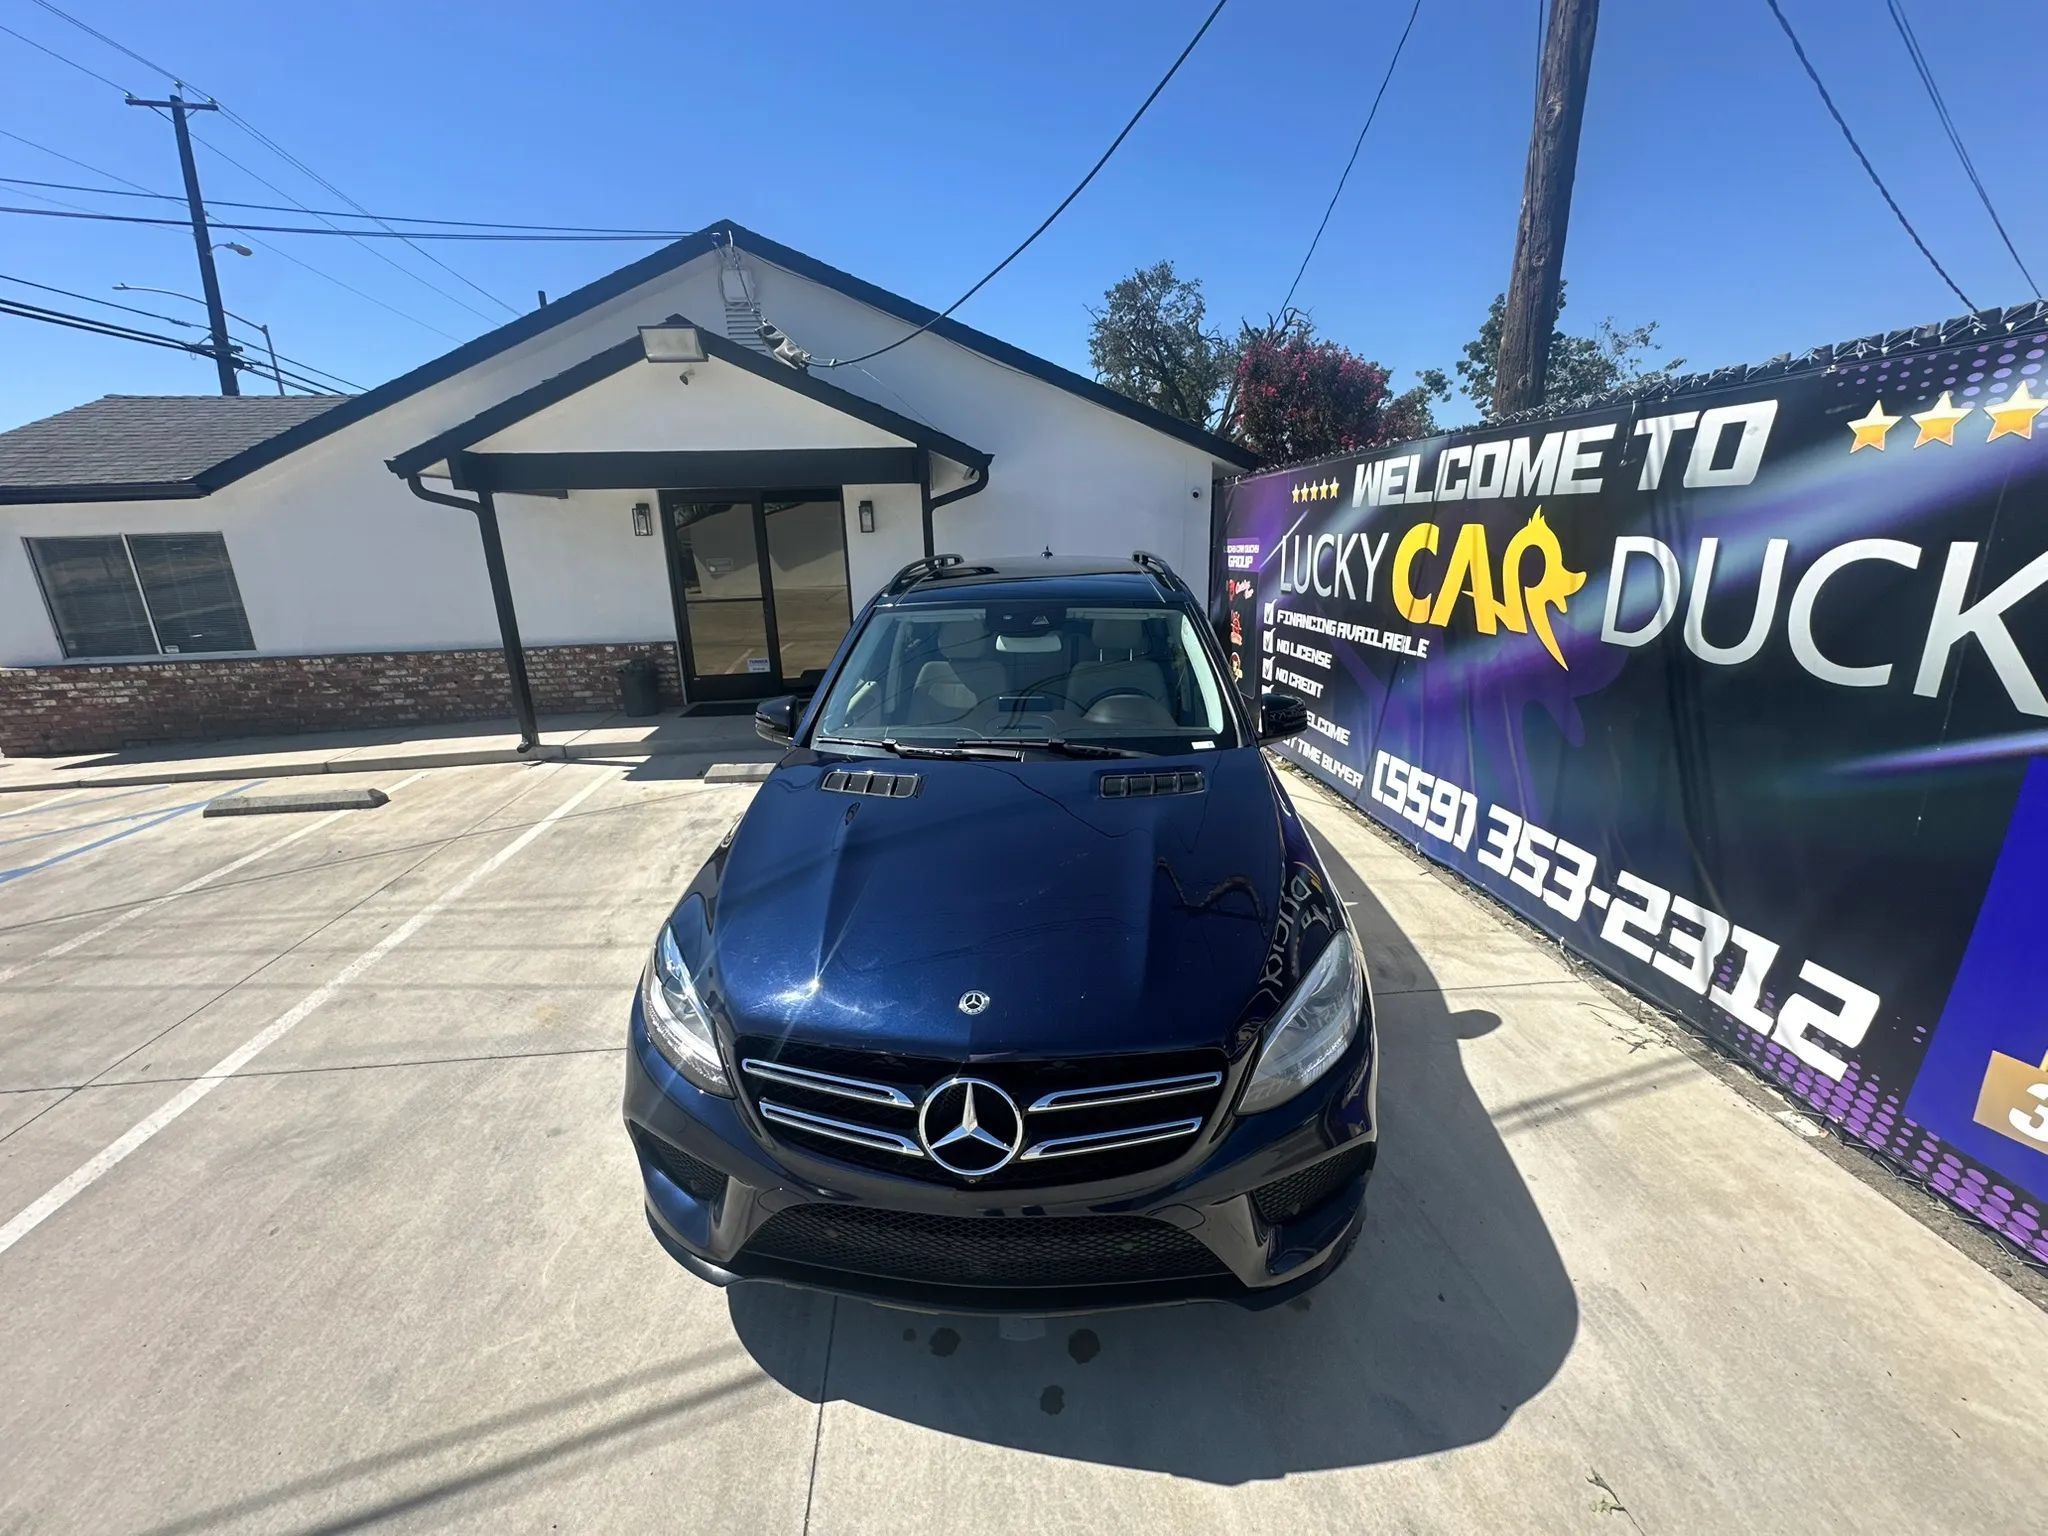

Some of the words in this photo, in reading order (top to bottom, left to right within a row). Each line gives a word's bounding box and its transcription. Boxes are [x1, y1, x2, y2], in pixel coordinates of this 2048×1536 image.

[1352, 423, 1617, 507] WELCOME
[1633, 399, 1778, 491] TO
[1228, 555, 1254, 569] GROUP
[1280, 532, 1389, 603] LUCKY
[1392, 504, 1587, 671] CAR
[1276, 638, 1290, 653] NO
[1290, 642, 1333, 669] LICENSE
[1277, 609, 1337, 637] FINANCING
[1337, 621, 1431, 659] AVAILABLE
[1275, 666, 1288, 684] NO
[1288, 670, 1324, 699] CREDIT
[1306, 710, 1351, 746] ELCOME
[1298, 738, 1322, 764] TIME
[1321, 752, 1364, 789] BUYER
[1371, 749, 1478, 853] (559)
[1477, 803, 1880, 1083] 353-2312
